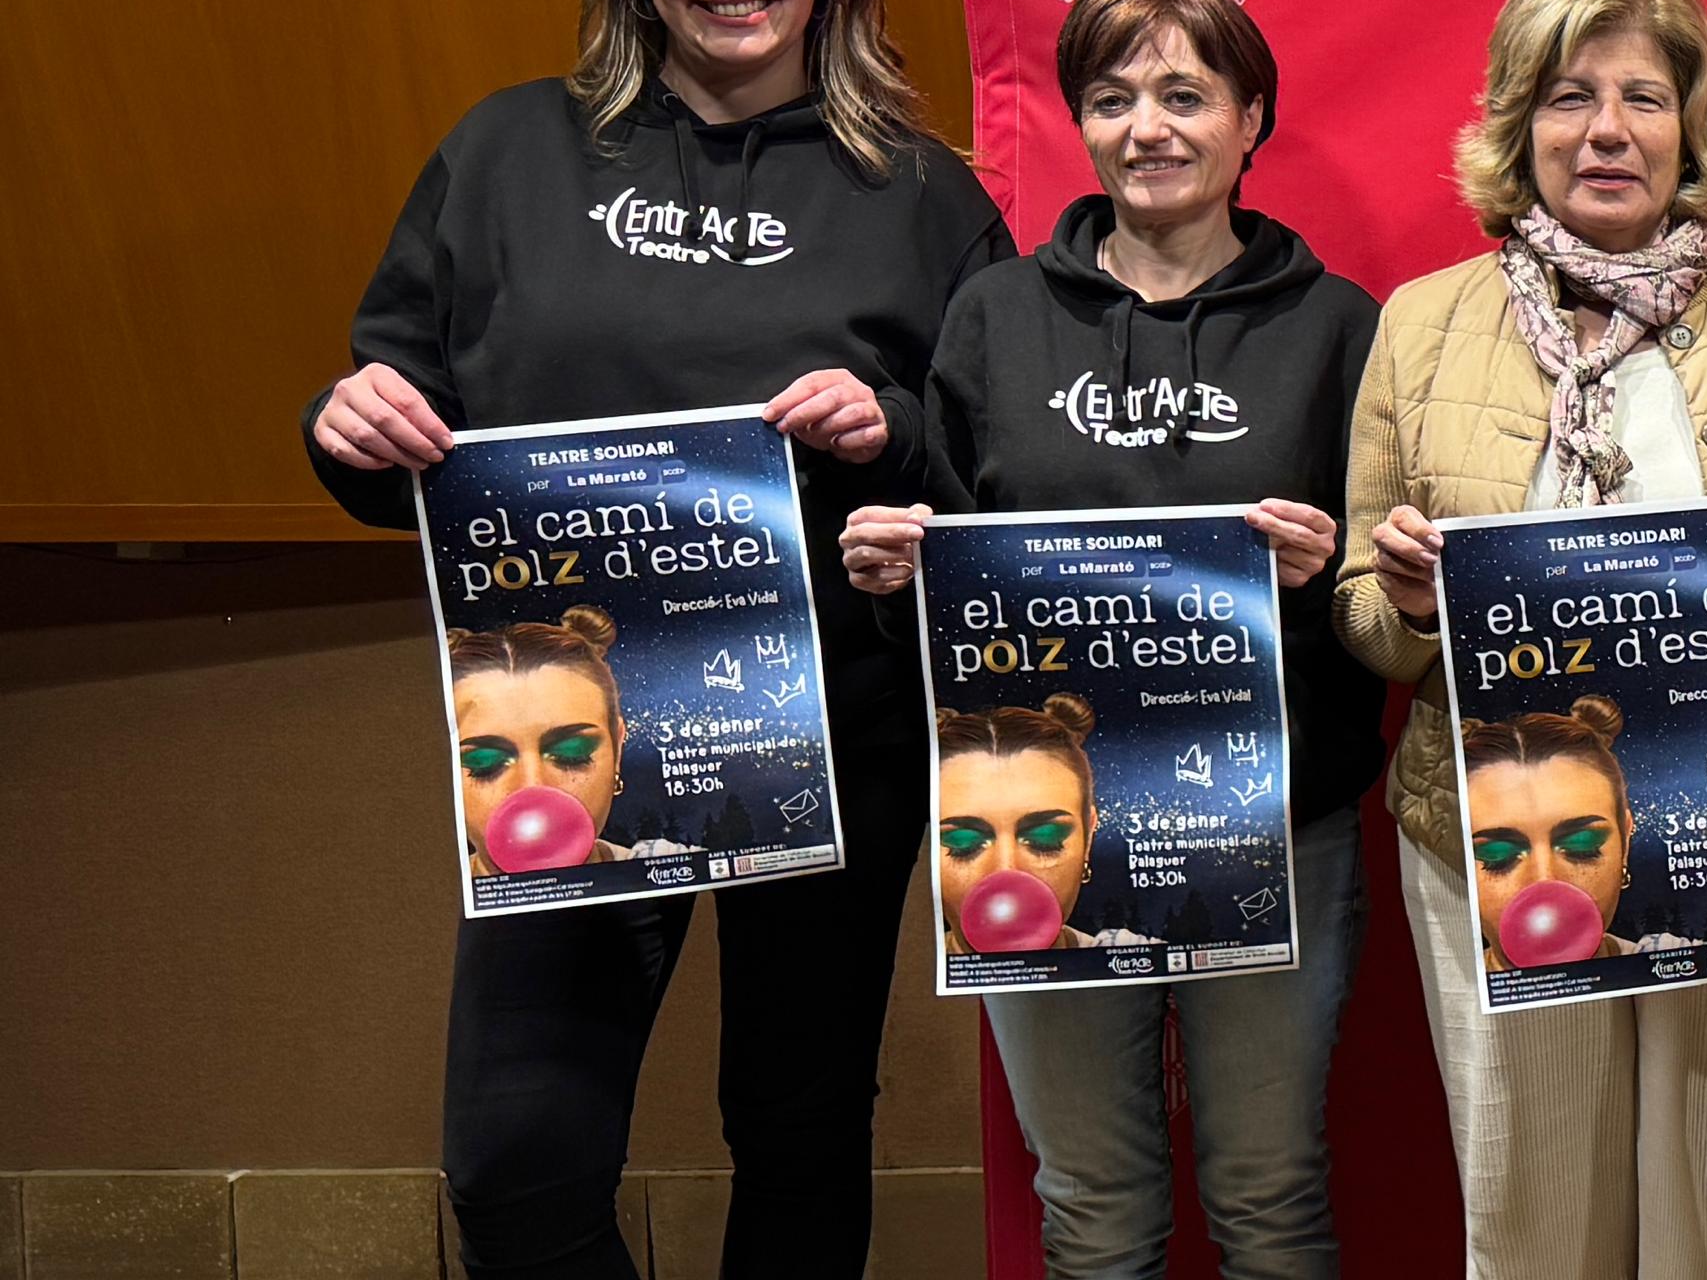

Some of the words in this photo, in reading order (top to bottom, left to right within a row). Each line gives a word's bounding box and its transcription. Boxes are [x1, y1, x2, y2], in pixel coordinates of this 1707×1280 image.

[626, 236, 710, 264] Teatre
[529, 449, 590, 467] TEATRE
[594, 441, 674, 461] SOLIDARI
[1089, 422, 1168, 448] Teatre
[469, 507, 518, 548] el
[536, 492, 674, 543] camí
[694, 489, 754, 527] de
[1547, 534, 1606, 552] TEATRE
[1609, 527, 1686, 547] SOLIDARI
[458, 549, 584, 602] polz
[604, 527, 781, 580] d'estel
[1026, 538, 1082, 553] TEATRE
[1086, 535, 1162, 551] SOLIDARI
[964, 591, 1009, 630] el
[1027, 584, 1156, 629] camí
[1177, 584, 1233, 622] de
[1487, 593, 1534, 635] el
[1552, 578, 1683, 630] camí
[952, 634, 1068, 683] polz
[1088, 625, 1256, 670] d'estel
[1475, 636, 1596, 691] polz
